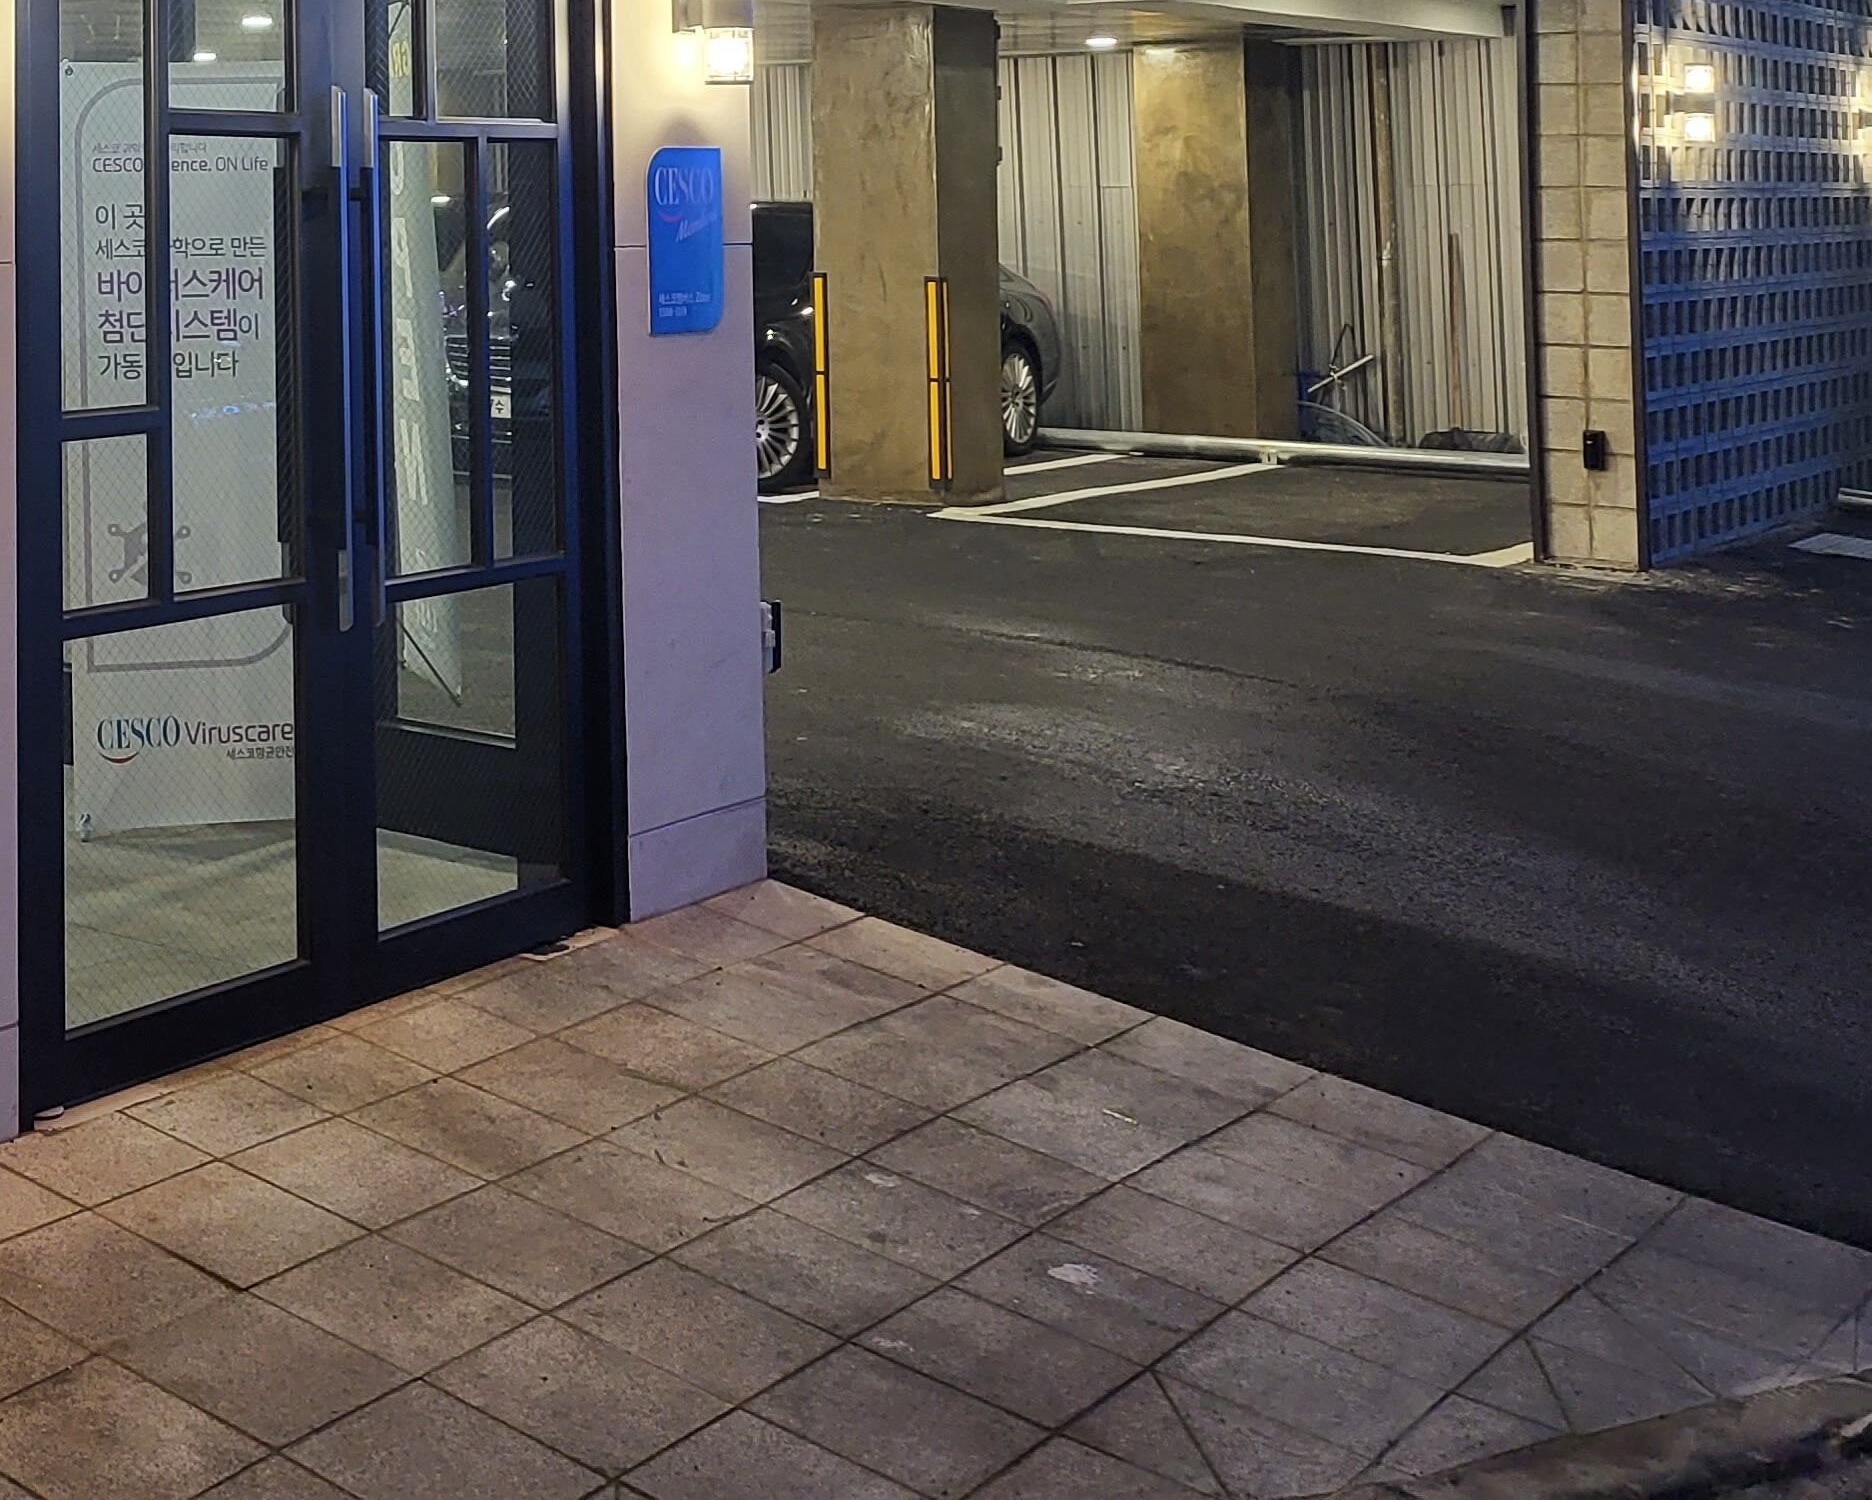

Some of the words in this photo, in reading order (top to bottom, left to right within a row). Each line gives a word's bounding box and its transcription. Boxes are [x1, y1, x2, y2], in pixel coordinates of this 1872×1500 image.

[92, 157, 144, 173] CESCO
[215, 156, 238, 171] ON
[241, 156, 269, 171] Life
[655, 167, 714, 206] CESCO
[95, 203, 116, 230] 이
[95, 238, 145, 260] 세스코
[171, 236, 226, 259] 학으로
[230, 236, 267, 258] 만든
[172, 350, 239, 379] 입니다
[97, 715, 180, 751] CESCO
[185, 721, 294, 745] Viruscare
